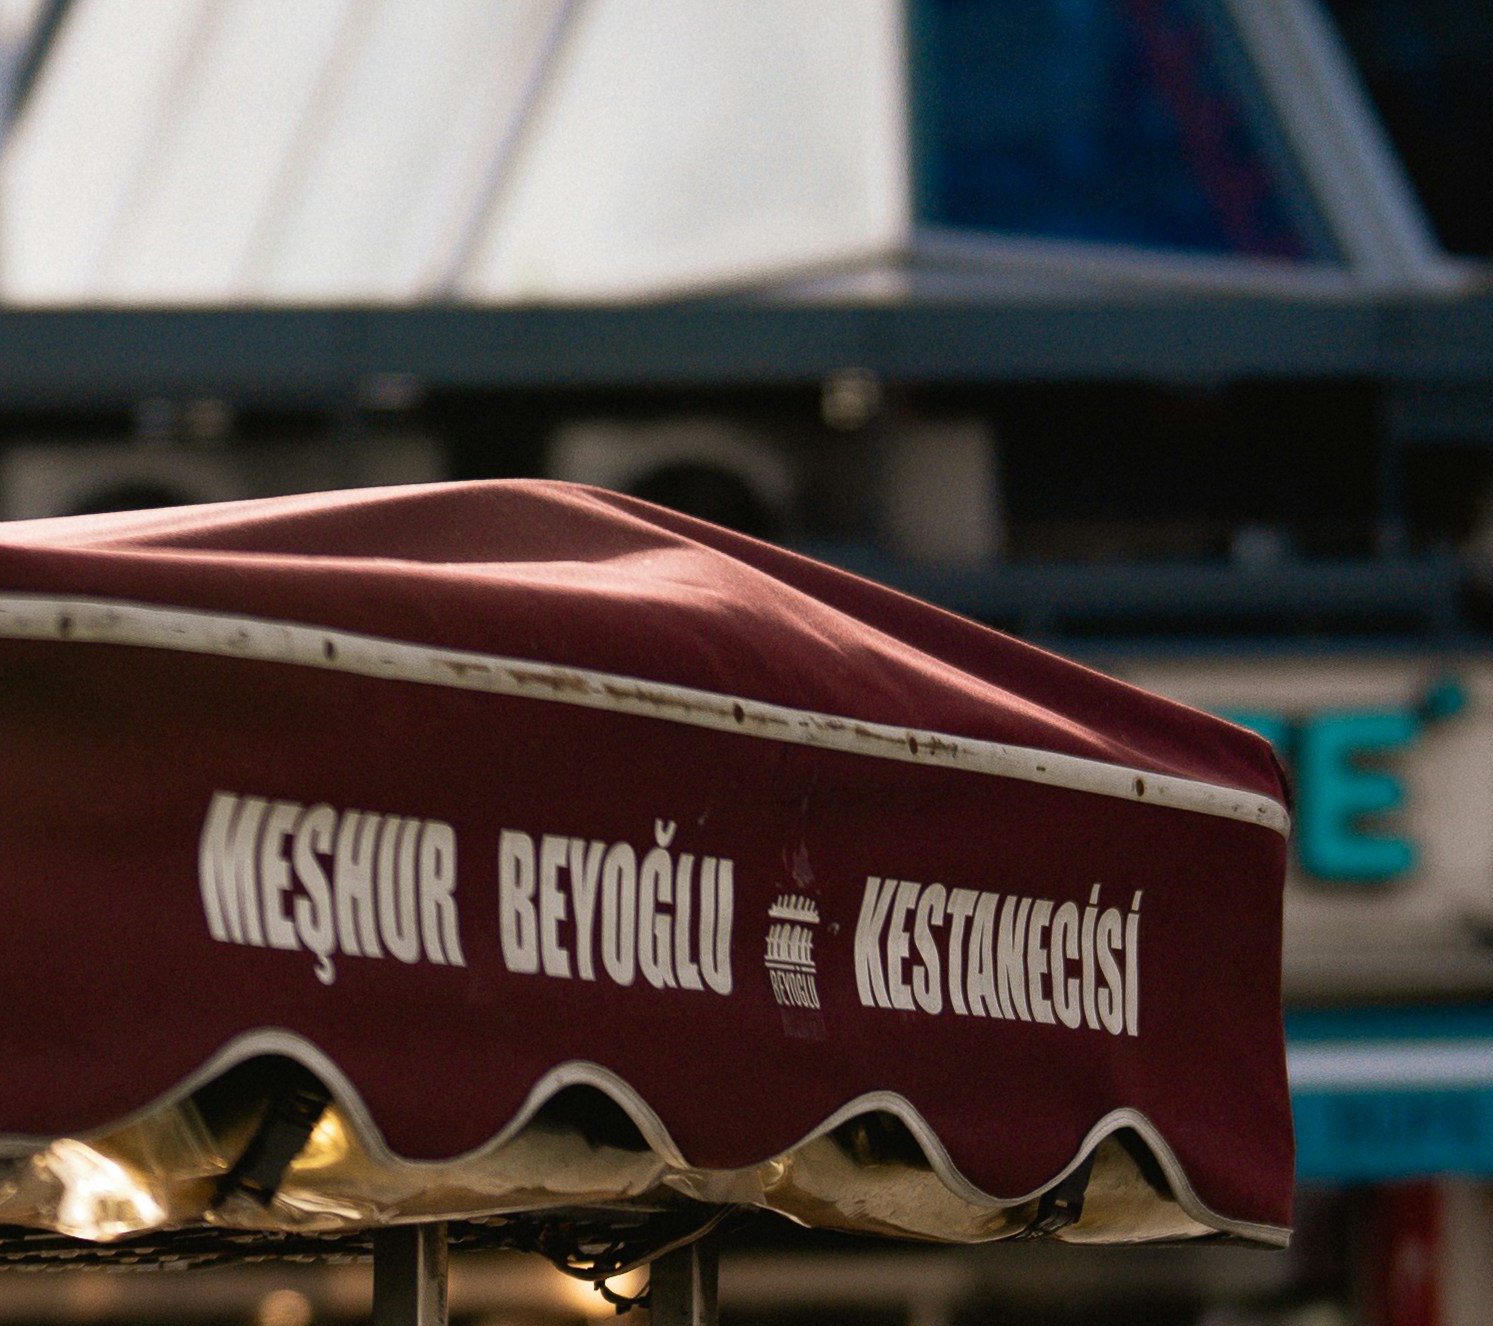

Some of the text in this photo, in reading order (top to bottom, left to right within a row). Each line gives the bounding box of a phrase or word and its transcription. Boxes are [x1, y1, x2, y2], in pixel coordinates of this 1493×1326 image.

[198, 790, 1144, 1037] MEŞHUR BEYOĞLU KESTANECİSİ
